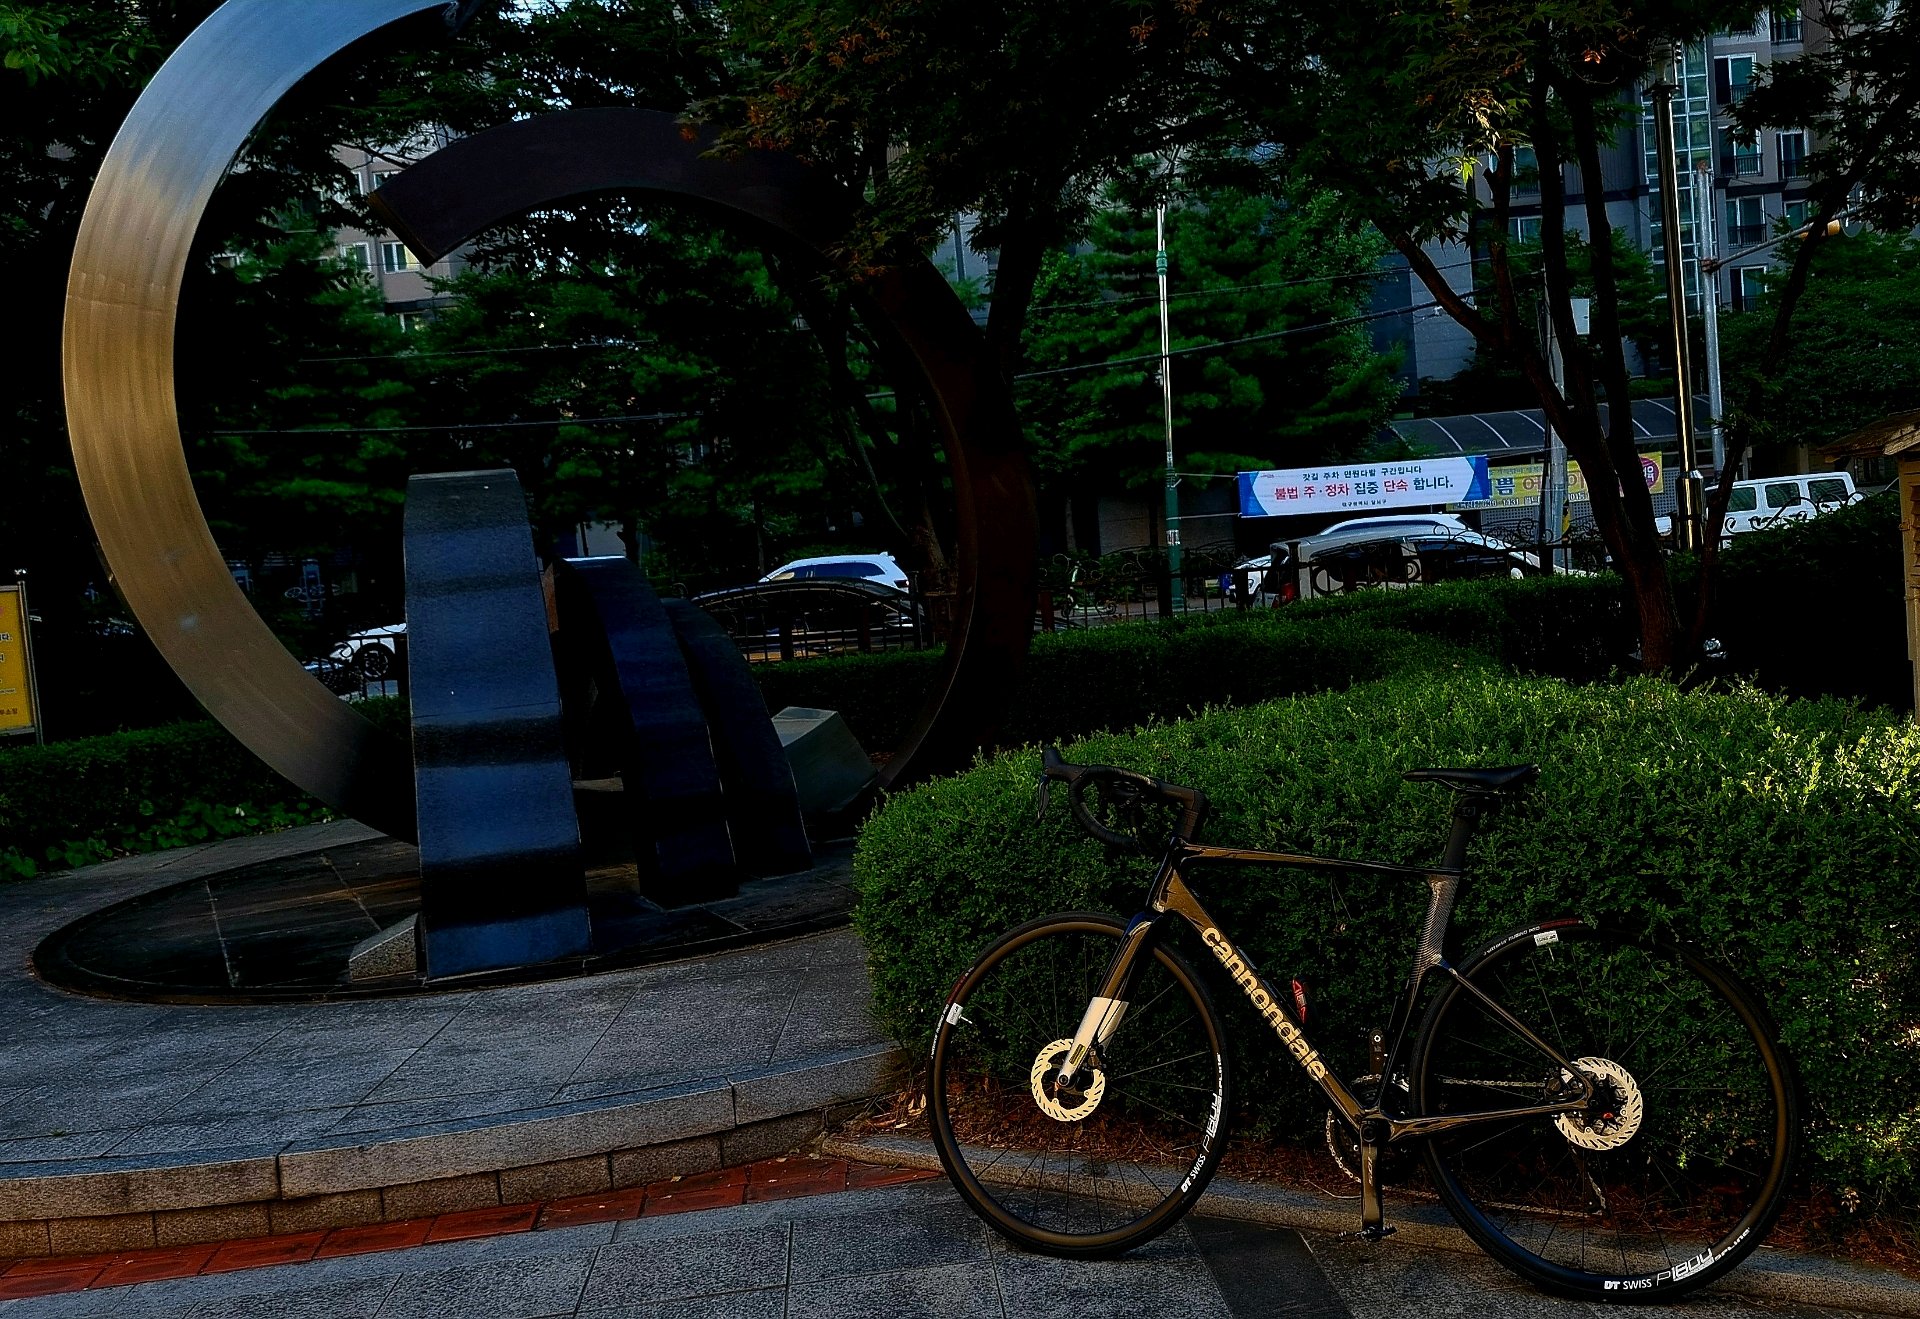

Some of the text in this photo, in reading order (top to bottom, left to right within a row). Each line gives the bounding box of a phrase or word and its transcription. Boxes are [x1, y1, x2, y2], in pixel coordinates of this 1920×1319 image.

[1323, 471, 1340, 480] 주차
[1381, 465, 1422, 476] 구간입니다
[1274, 486, 1298, 500] 불법
[1354, 481, 1379, 495] 집중
[1384, 479, 1409, 492] 단속
[1413, 475, 1454, 491] 합니다.
[1202, 927, 1326, 1082] cannondale
[1180, 1177, 1193, 1193] DT
[1189, 1153, 1206, 1180] SWISS
[1604, 1280, 1620, 1290] DT
[1622, 1278, 1652, 1290] SWISS
